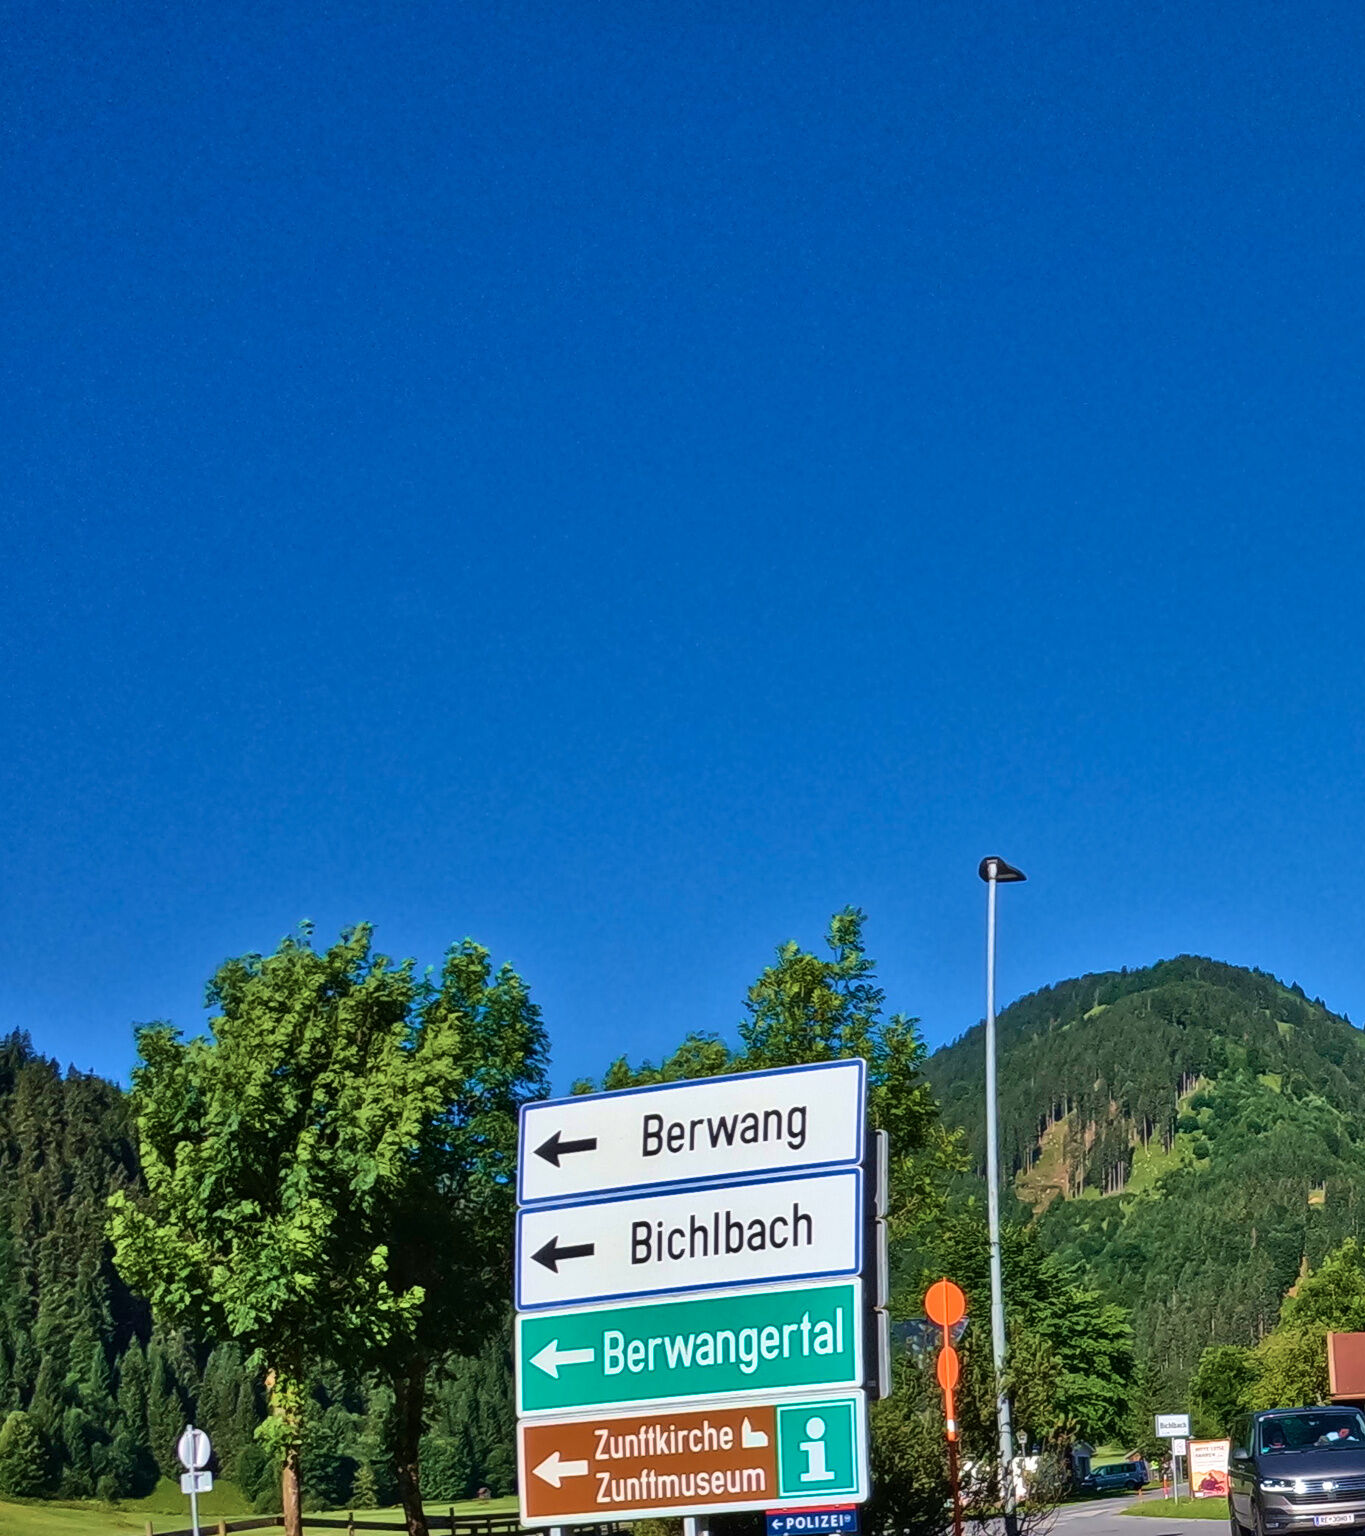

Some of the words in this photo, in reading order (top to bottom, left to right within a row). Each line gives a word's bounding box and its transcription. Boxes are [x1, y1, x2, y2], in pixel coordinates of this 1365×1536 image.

[642, 1105, 807, 1158] Berwang
[630, 1202, 814, 1265] Bichlbach
[602, 1308, 845, 1375] Berwangertal
[593, 1420, 733, 1460] Zunftkirche
[597, 1466, 765, 1504] Zunftmuseum
[786, 1514, 844, 1530] POLIZEI
